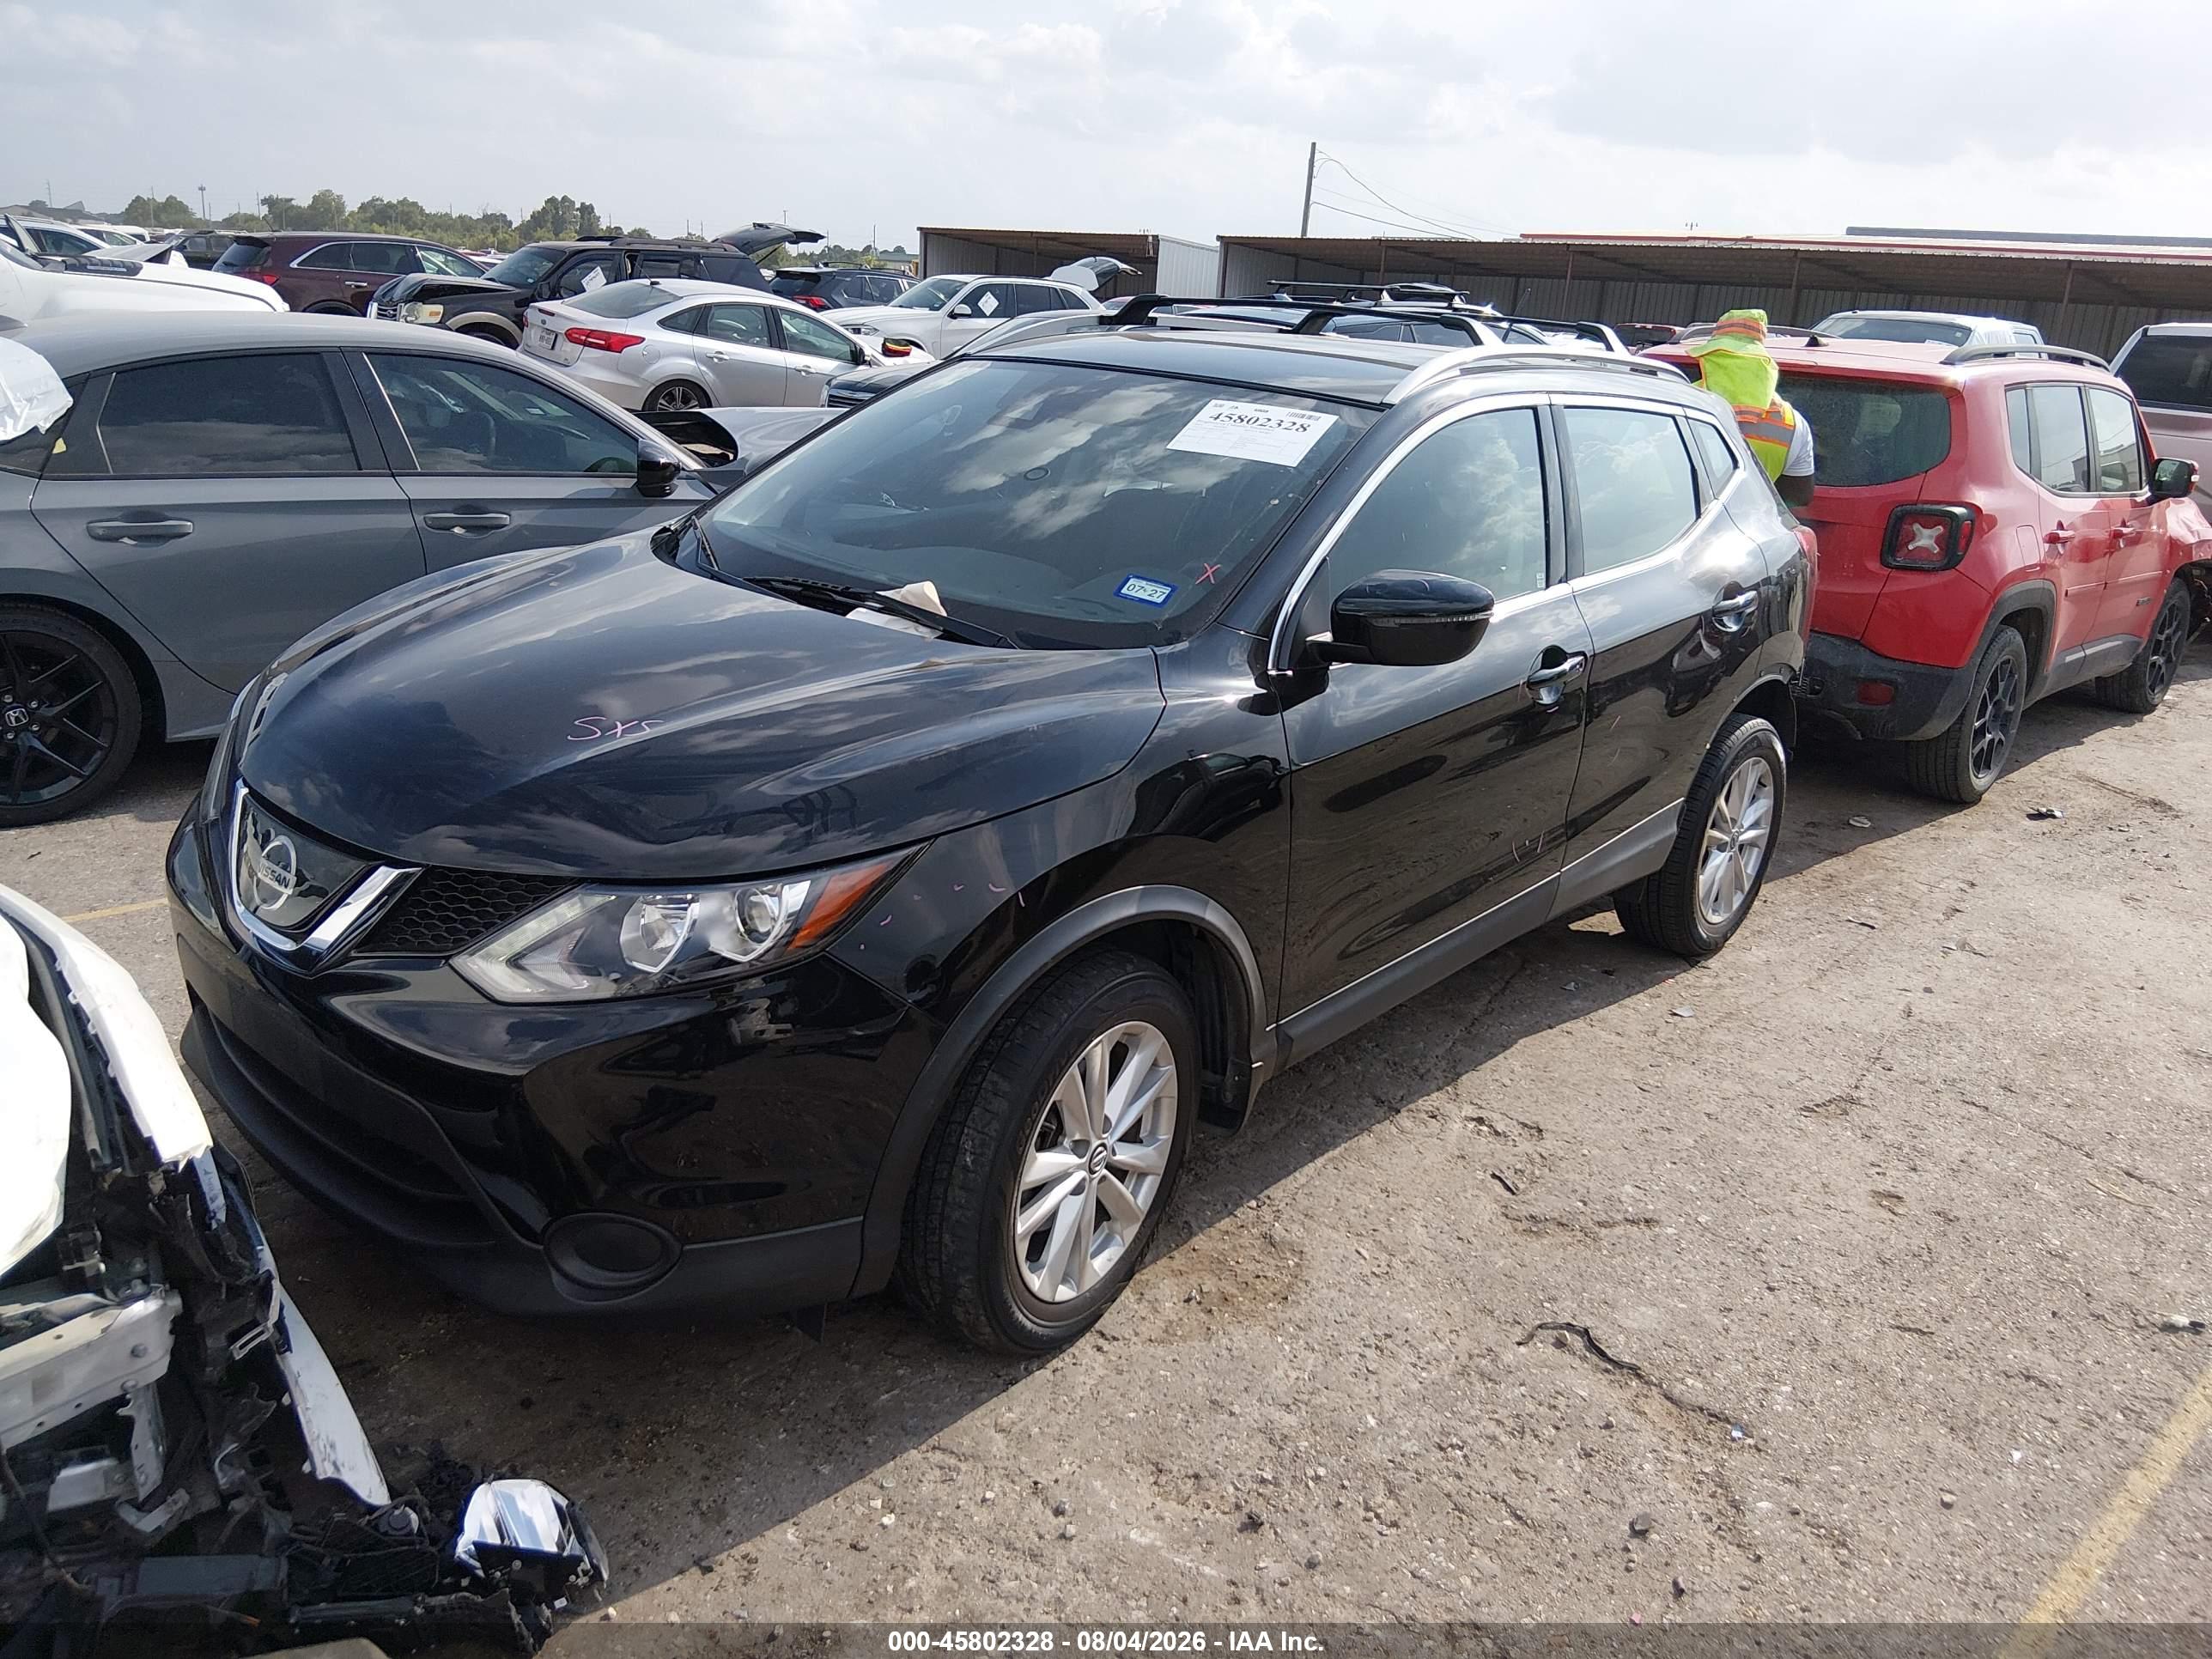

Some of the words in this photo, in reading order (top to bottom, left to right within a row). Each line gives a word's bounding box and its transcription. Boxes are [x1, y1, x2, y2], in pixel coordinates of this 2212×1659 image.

[1209, 412, 1311, 433] 45802328
[1127, 583, 1145, 593] 07
[1147, 589, 1167, 599] 27
